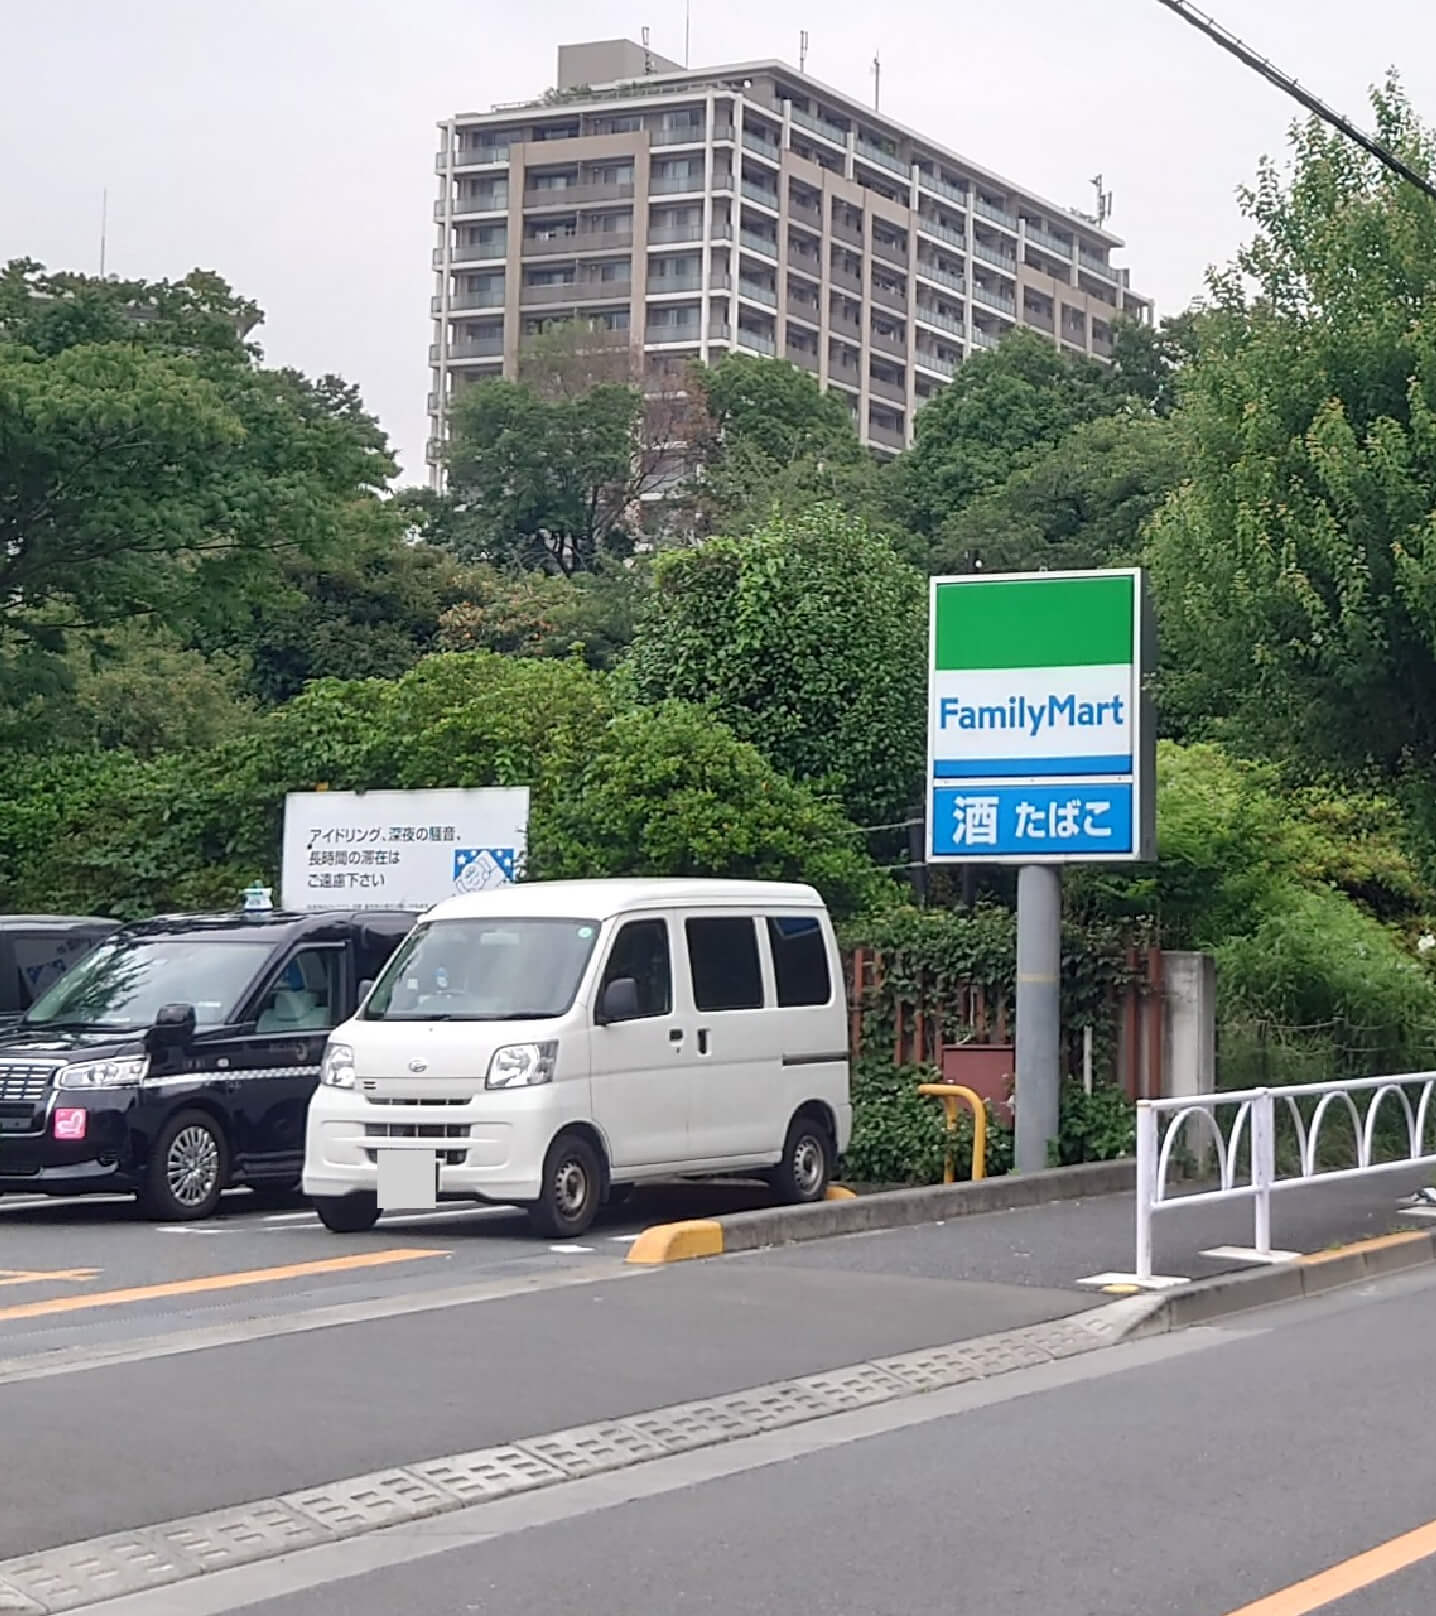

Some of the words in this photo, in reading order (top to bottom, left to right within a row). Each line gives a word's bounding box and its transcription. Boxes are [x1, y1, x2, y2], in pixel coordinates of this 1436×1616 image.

[940, 694, 1123, 736] FamilyMart
[953, 796, 999, 845] 酒
[1015, 798, 1112, 839] たばこ
